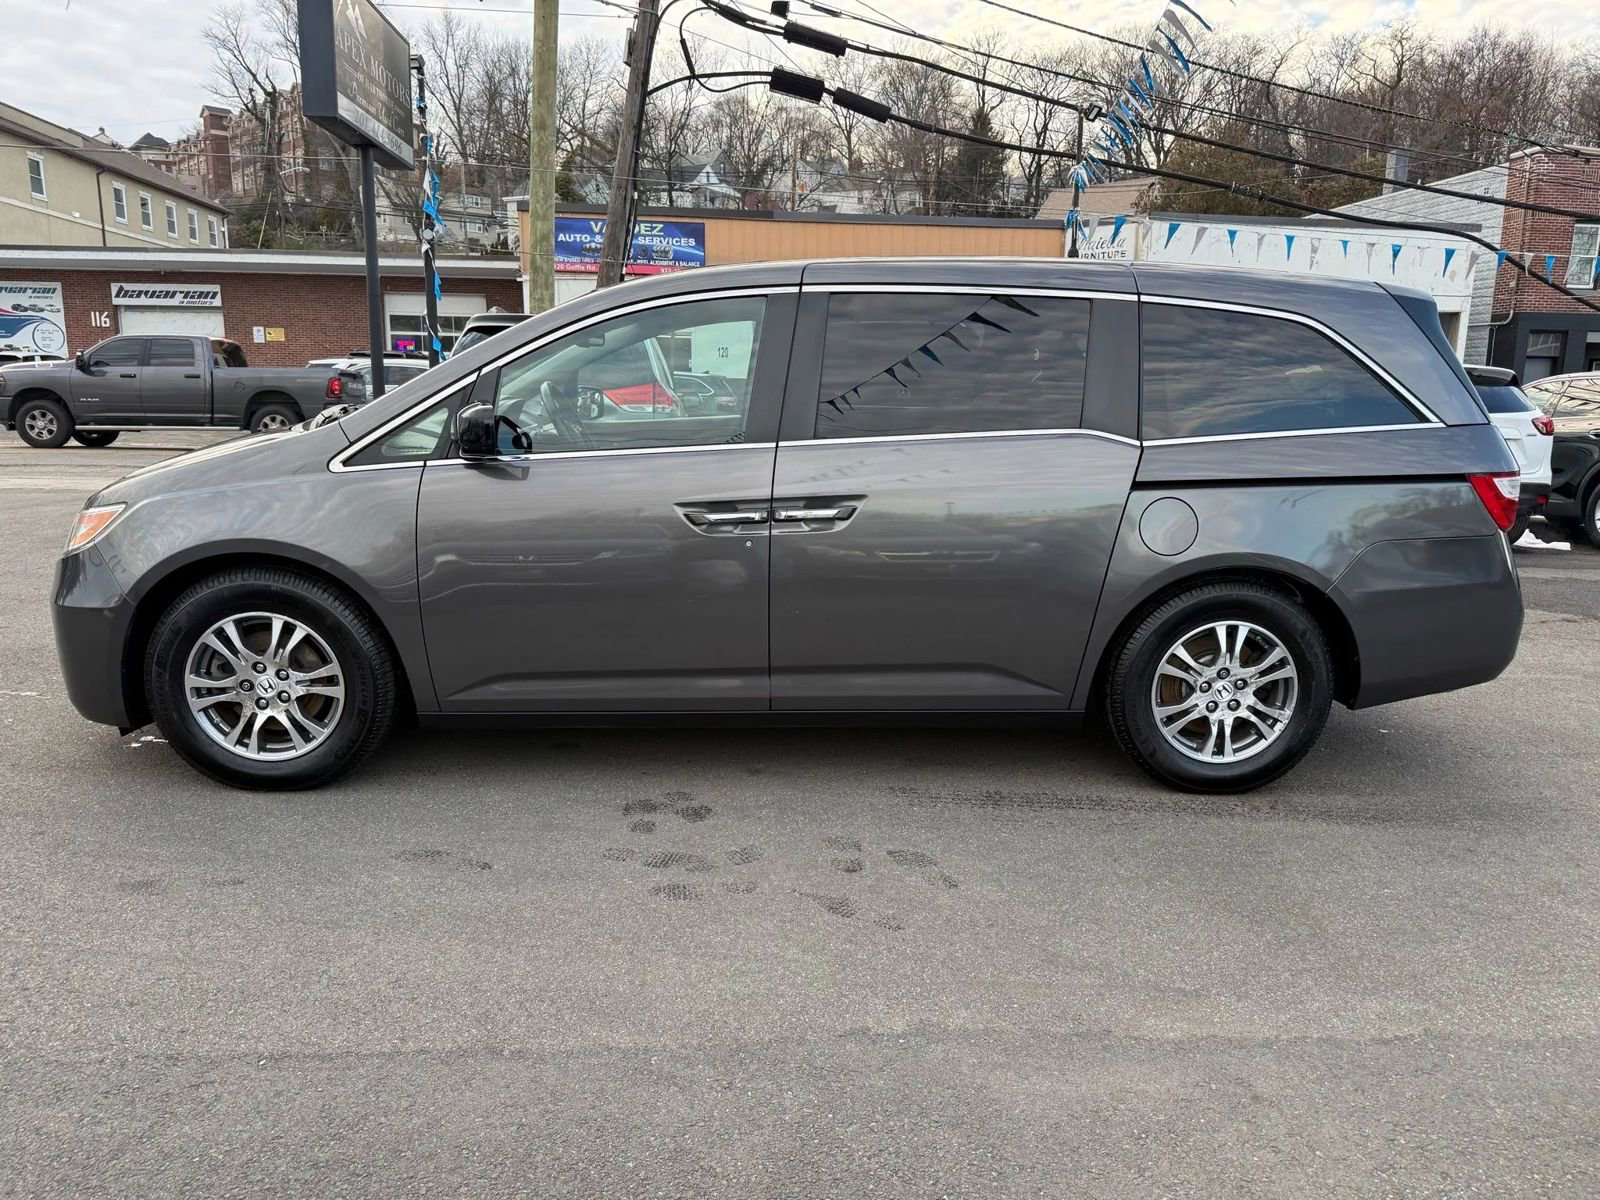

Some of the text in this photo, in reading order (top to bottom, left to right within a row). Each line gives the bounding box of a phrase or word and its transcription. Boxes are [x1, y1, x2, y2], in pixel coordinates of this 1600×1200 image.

[336, 26, 411, 108] APEX MOTORS
[557, 233, 590, 242] AUTO
[638, 236, 696, 246] SERVICES
[0, 286, 57, 295] varian
[114, 284, 219, 300] bavarian
[91, 311, 110, 328] 116
[717, 346, 728, 358] 120
